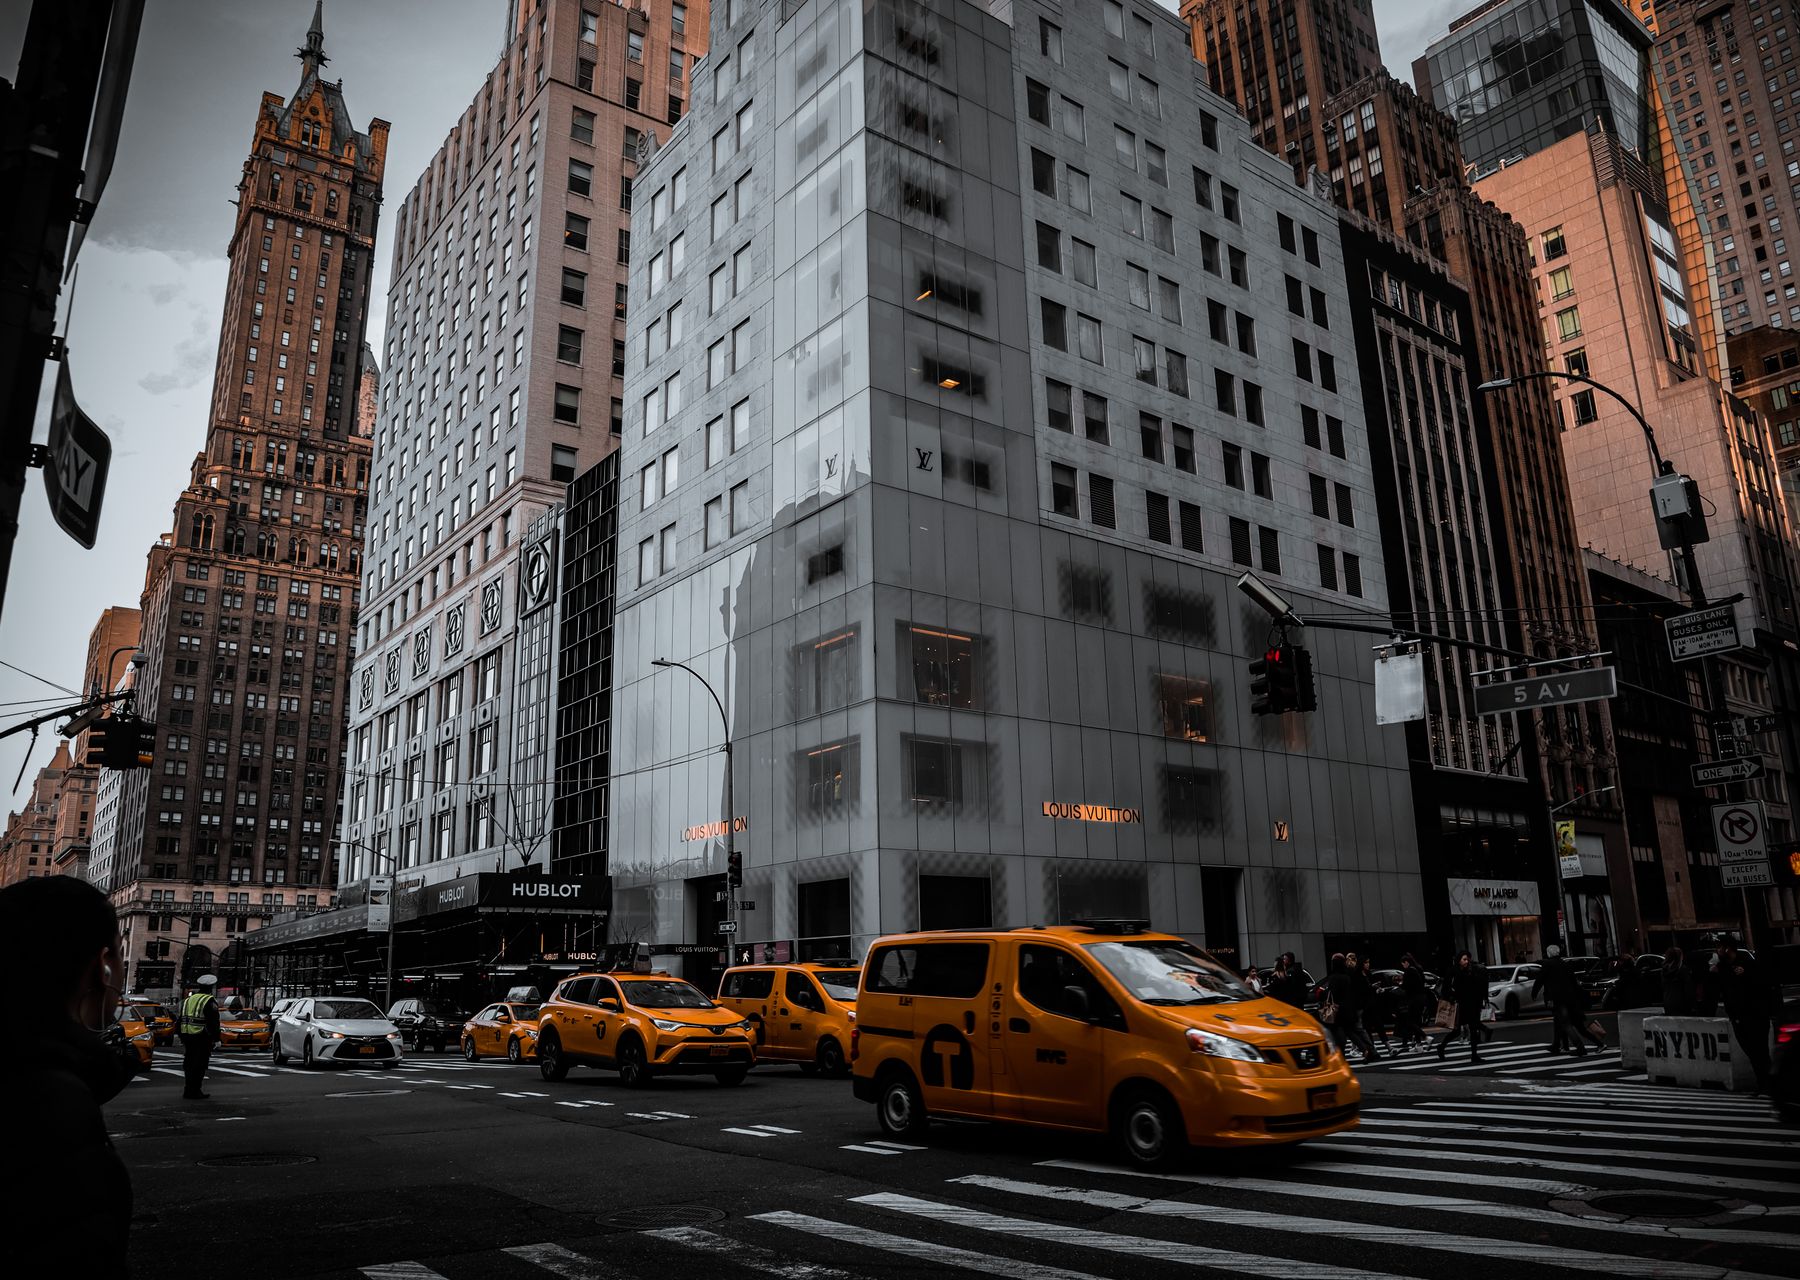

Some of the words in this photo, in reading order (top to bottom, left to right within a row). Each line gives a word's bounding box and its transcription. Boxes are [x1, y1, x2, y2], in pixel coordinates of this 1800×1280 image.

[60, 444, 90, 496] AY
[1684, 614, 1702, 624] BUS
[1704, 608, 1728, 619] LANE
[1673, 624, 1703, 637] BUSES
[1706, 618, 1729, 630] ONLY
[1514, 685, 1528, 703] 5
[1753, 719, 1760, 732] 5
[1702, 769, 1723, 779] ONE
[1731, 764, 1753, 774] WAY
[1042, 801, 1082, 819] LOUIS
[1086, 806, 1140, 824] VUITTON
[680, 825, 705, 843] LOUIS
[707, 816, 748, 837] VUITON
[1731, 865, 1758, 874] EXCEPT
[1726, 876, 1740, 884] MTA
[1743, 874, 1767, 883] BUSES
[439, 886, 465, 904] HUBLOT
[512, 883, 582, 898] HUBLOT
[1473, 888, 1490, 898] SAINT
[1492, 888, 1518, 898] LAURENT
[1654, 1030, 1718, 1061] NYPD
